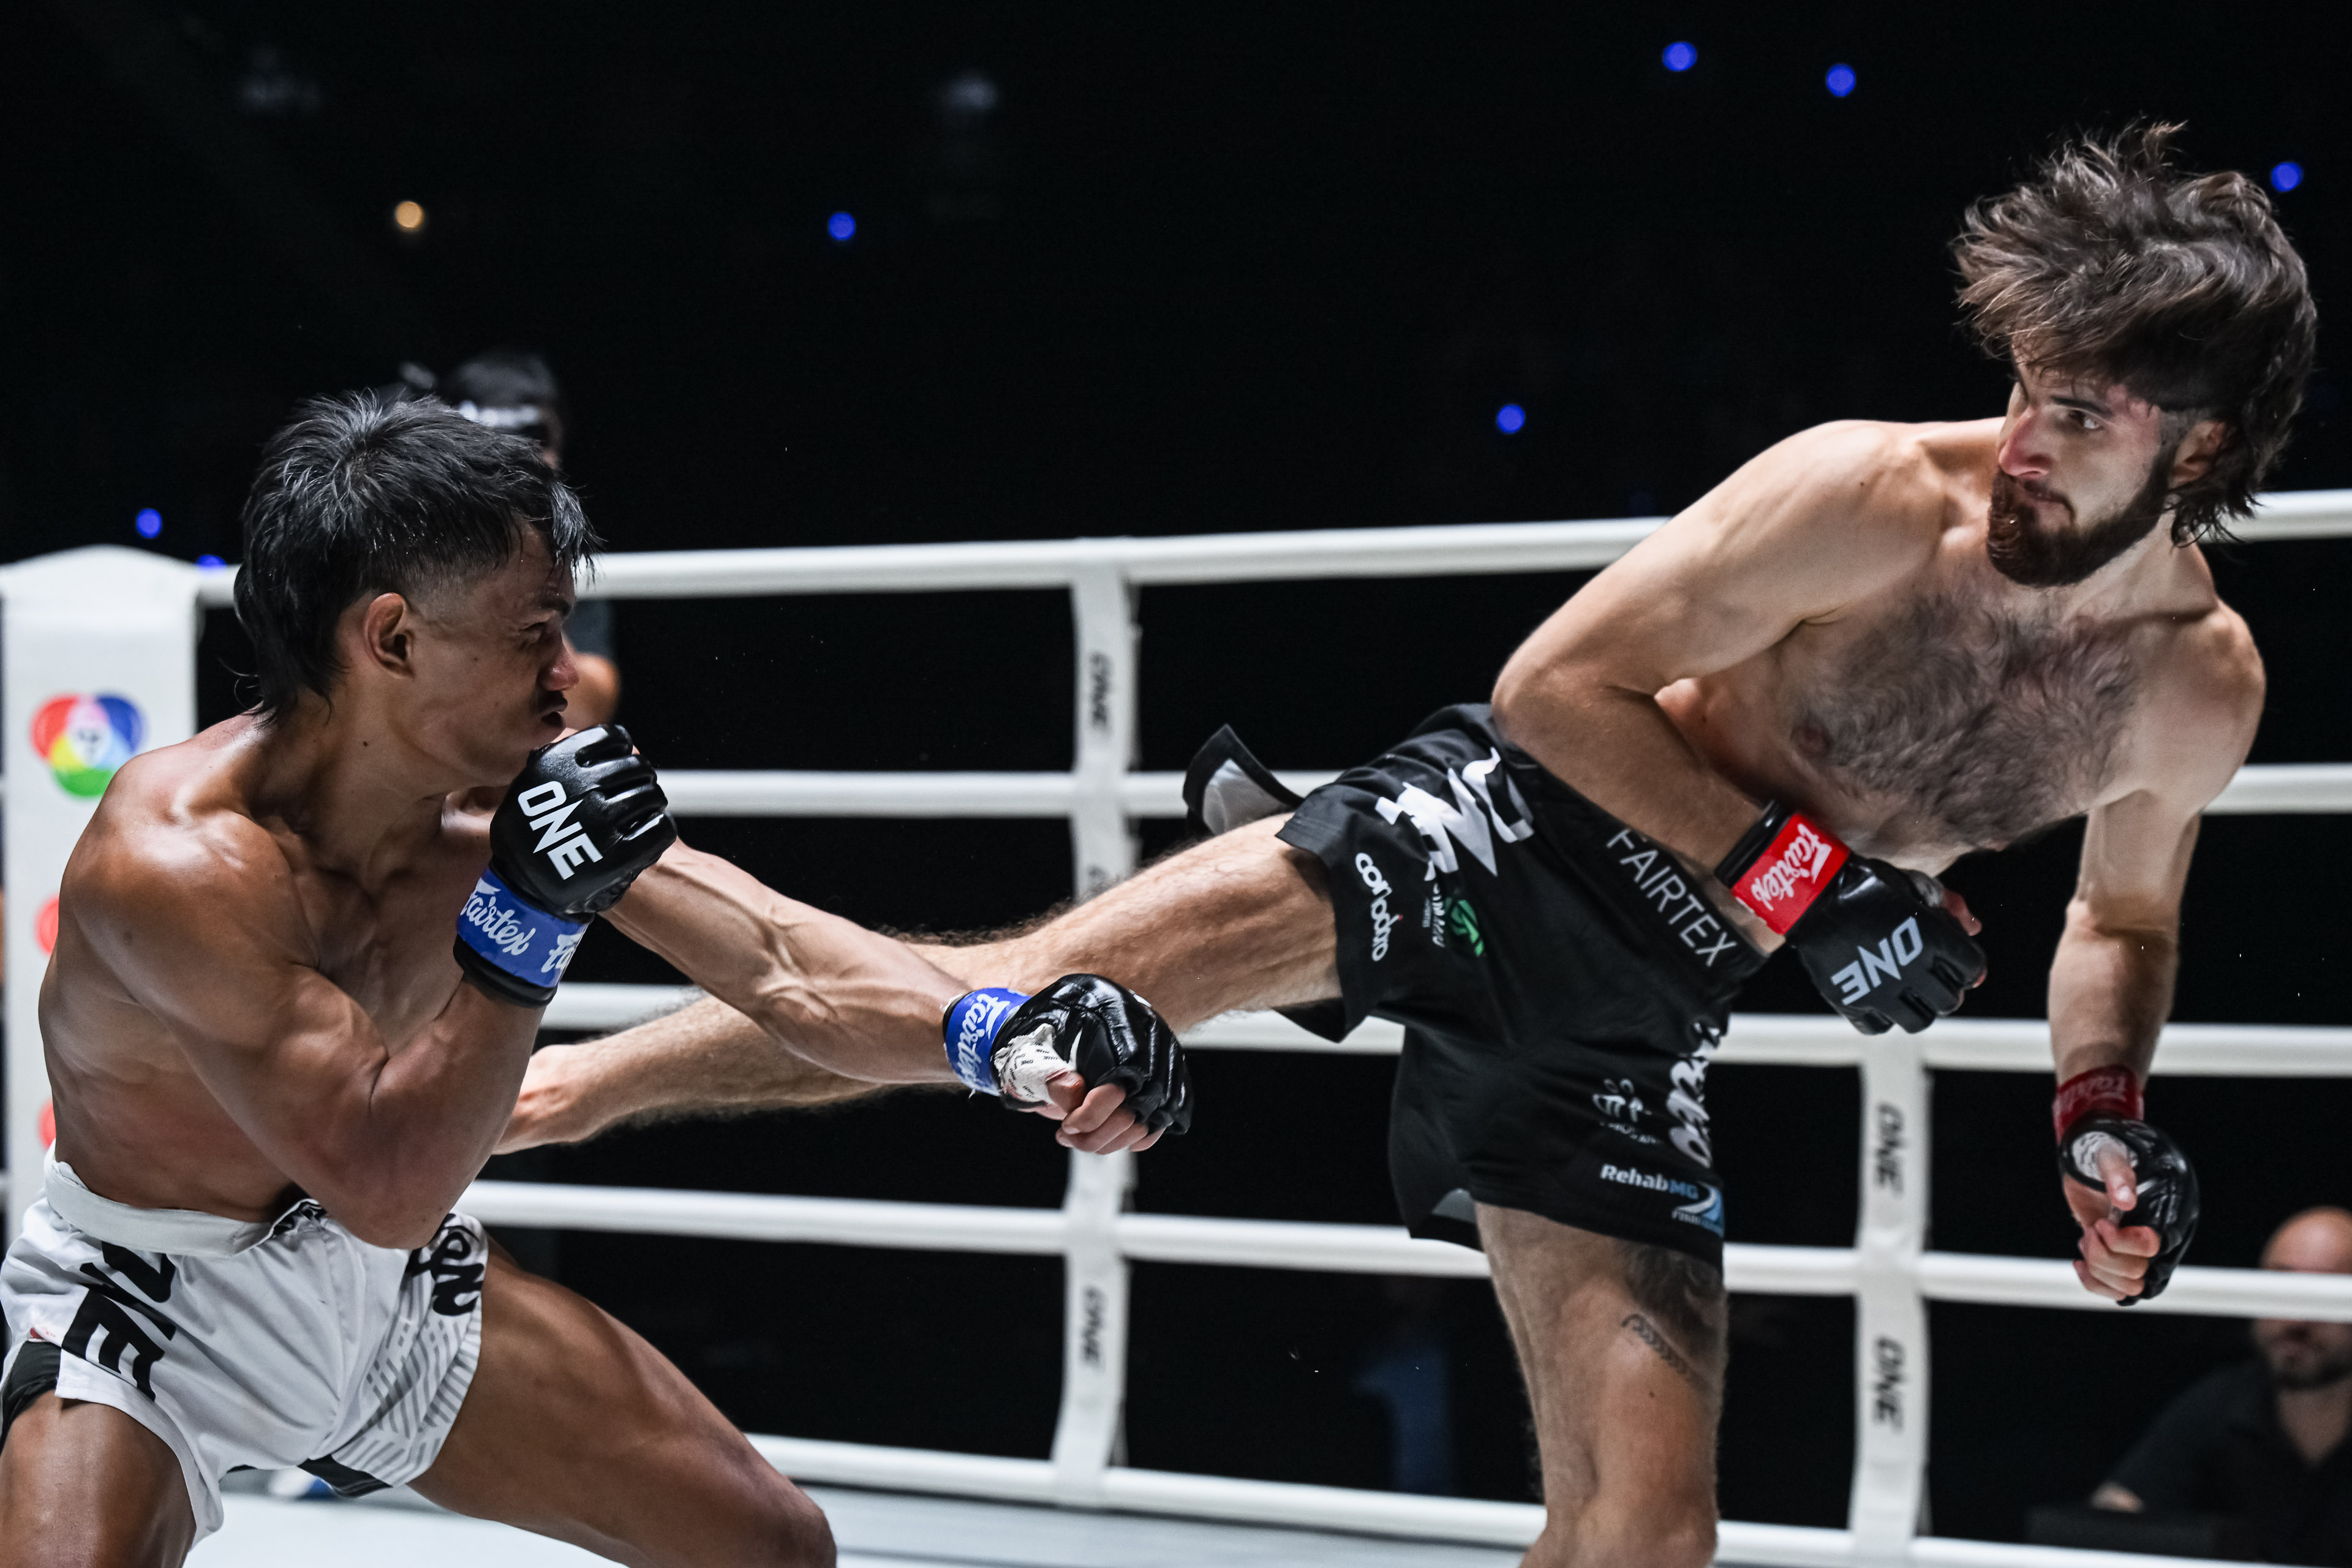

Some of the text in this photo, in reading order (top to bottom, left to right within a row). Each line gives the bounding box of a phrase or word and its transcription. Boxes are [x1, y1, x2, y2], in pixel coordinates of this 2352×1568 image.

[518, 780, 604, 880] ONE
[1750, 823, 1833, 911] Fairtex
[1606, 829, 1738, 967] FAIRTEX
[1831, 916, 1923, 1006] ONE
[1874, 1101, 1905, 1196] ONE
[61, 1241, 177, 1403] NE
[1872, 1334, 1905, 1434] ONE
